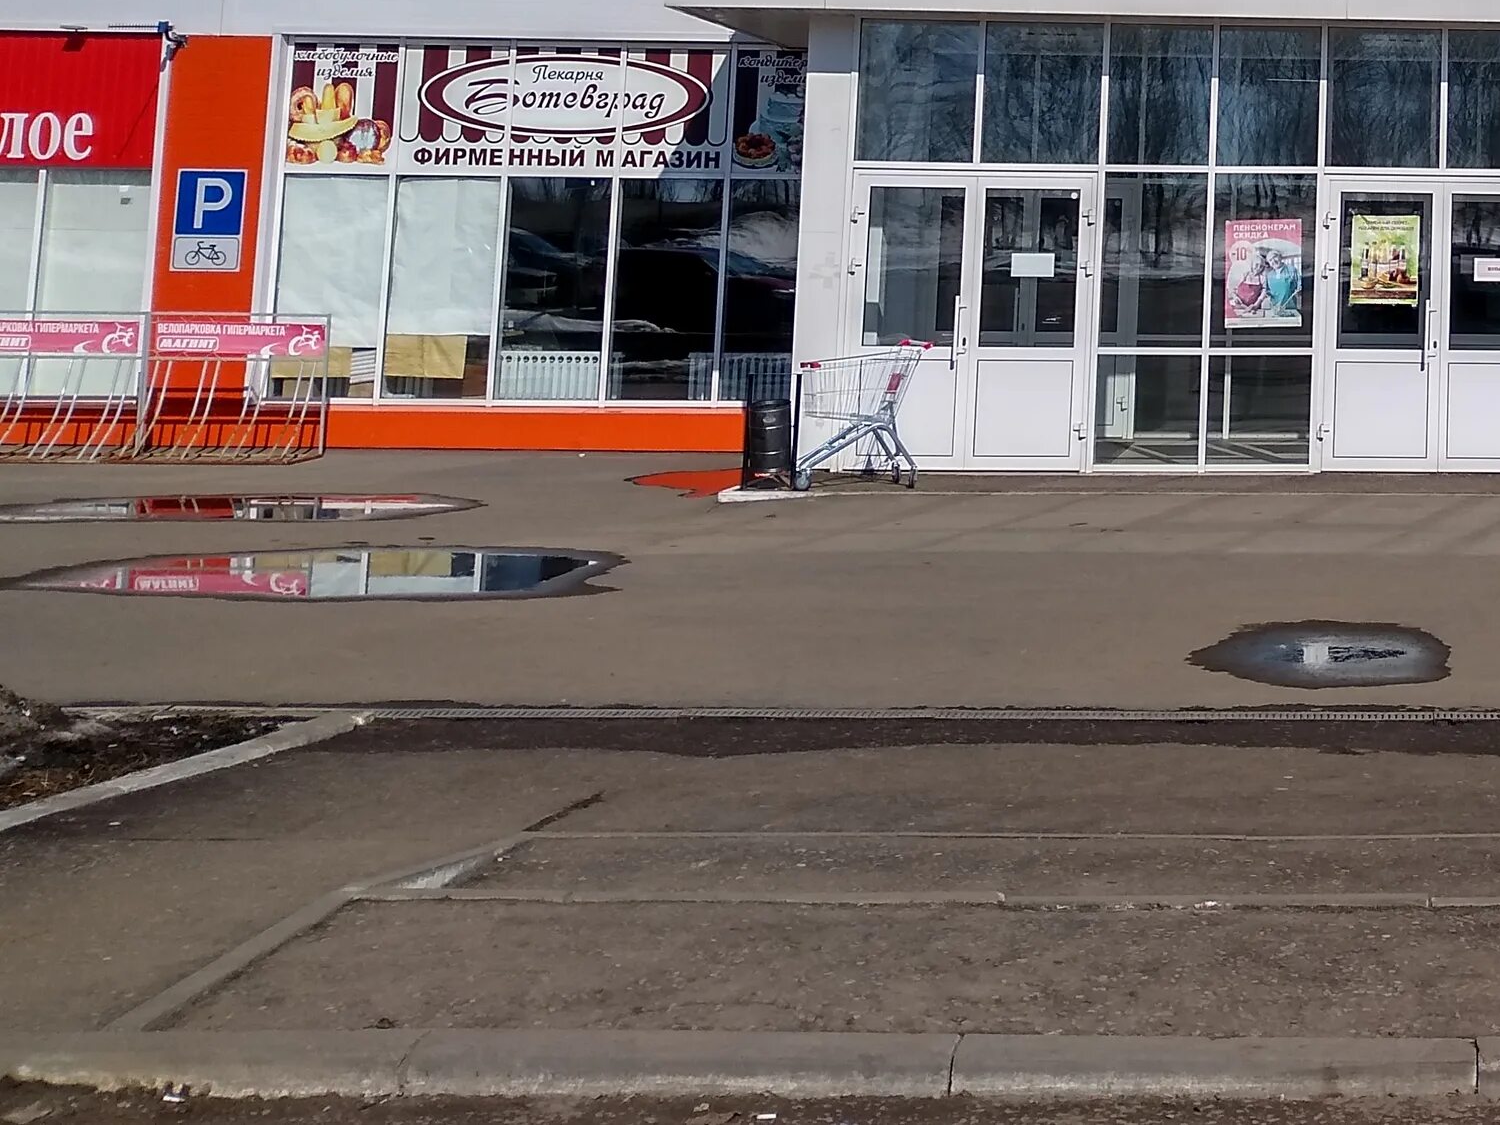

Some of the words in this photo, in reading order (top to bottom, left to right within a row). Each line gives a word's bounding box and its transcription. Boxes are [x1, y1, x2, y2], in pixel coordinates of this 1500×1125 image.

[295, 48, 399, 63] хлебобулочные
[316, 62, 374, 80] изделия
[532, 64, 604, 83] Пекарня
[0, 112, 94, 161] лое
[412, 146, 586, 168] ФИРМЕННЫЙ
[595, 148, 721, 170] МАГАЗИН
[193, 177, 234, 229] P
[1233, 223, 1297, 232] ПЕНСИОНЕРАМ
[1233, 231, 1270, 240] СКИДКА
[34, 322, 100, 334] ГИПЕРМАРКЕТА
[157, 322, 221, 335] ВЕЛОПАРКОВКА
[222, 324, 286, 336] ГИПЕРМАРКЕТА
[159, 338, 217, 349] МАГНИТ
